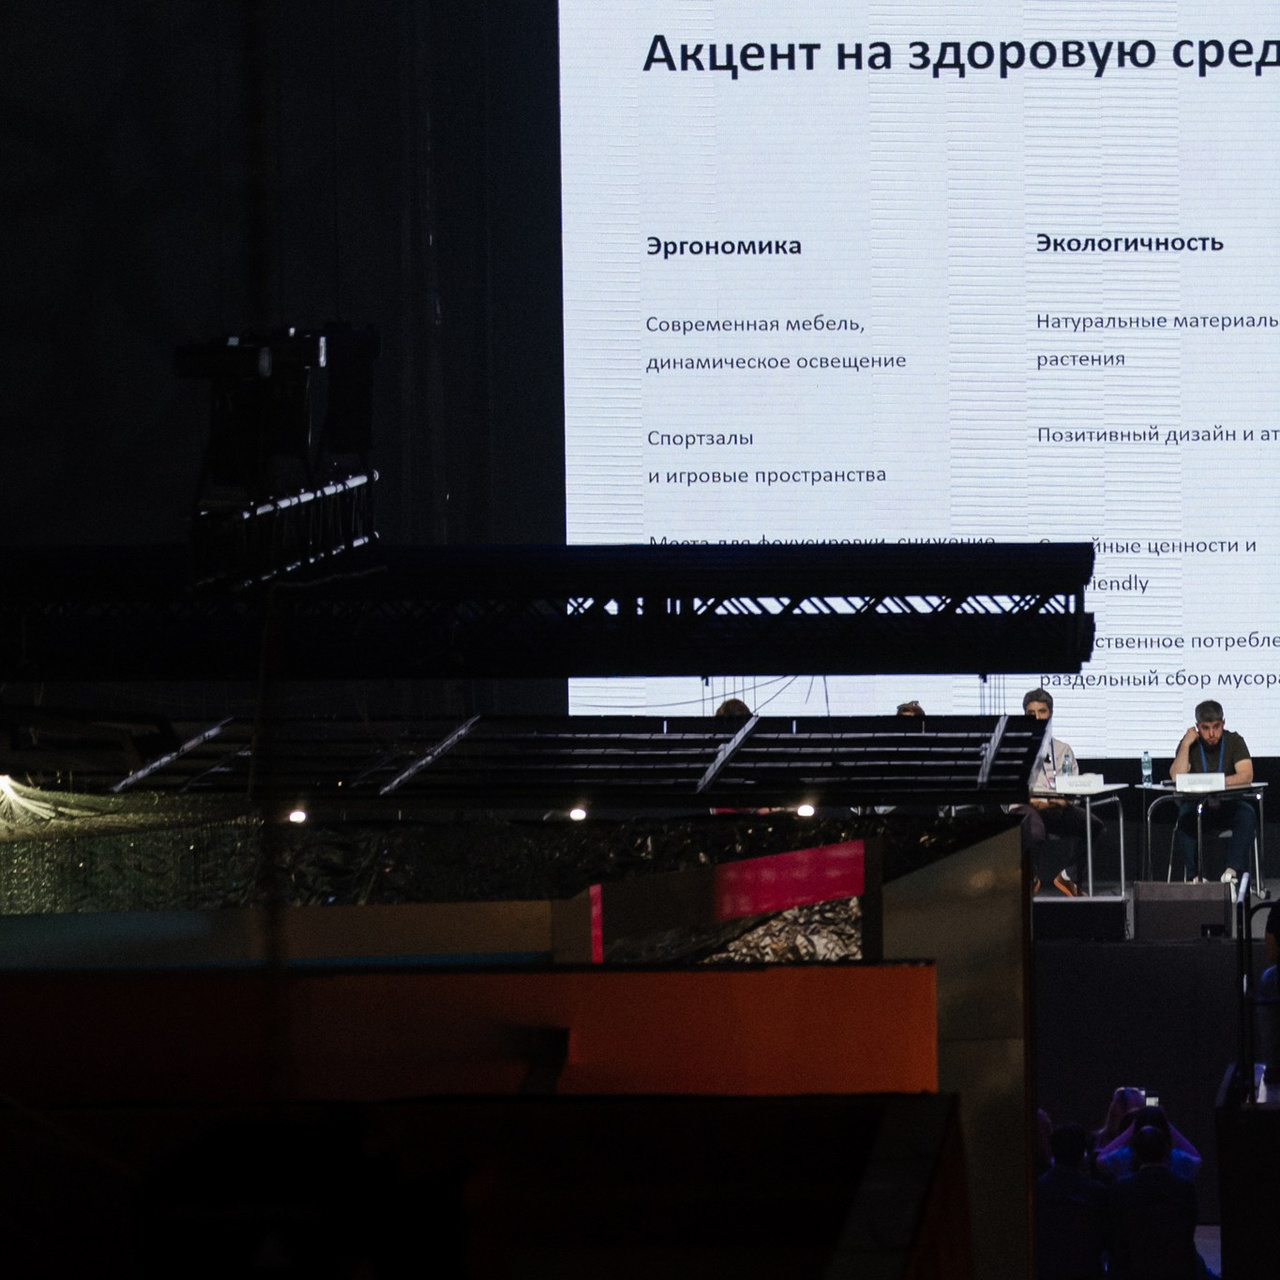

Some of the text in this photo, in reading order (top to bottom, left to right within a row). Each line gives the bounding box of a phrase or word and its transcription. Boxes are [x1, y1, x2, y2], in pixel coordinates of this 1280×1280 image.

[642, 34, 821, 79] Акцент
[836, 41, 892, 71] на
[908, 38, 1157, 78] здоровую
[646, 236, 802, 258] Эргономика
[1036, 232, 1225, 253] Экологичность
[646, 313, 865, 336] Современная мебель,
[1036, 312, 1168, 333] Натуральные
[645, 355, 907, 374] динамическое освещение
[1037, 353, 1126, 371] растения
[647, 430, 754, 450] Спортзалы
[1037, 424, 1159, 443] Позитивный
[1164, 424, 1237, 446] дизайн
[1242, 427, 1255, 443] и
[648, 468, 887, 488] и игровые пространства
[1147, 539, 1239, 557] ценности
[1245, 539, 1257, 554] и
[1039, 668, 1159, 690] раздельный
[1165, 668, 1212, 689] сбор
